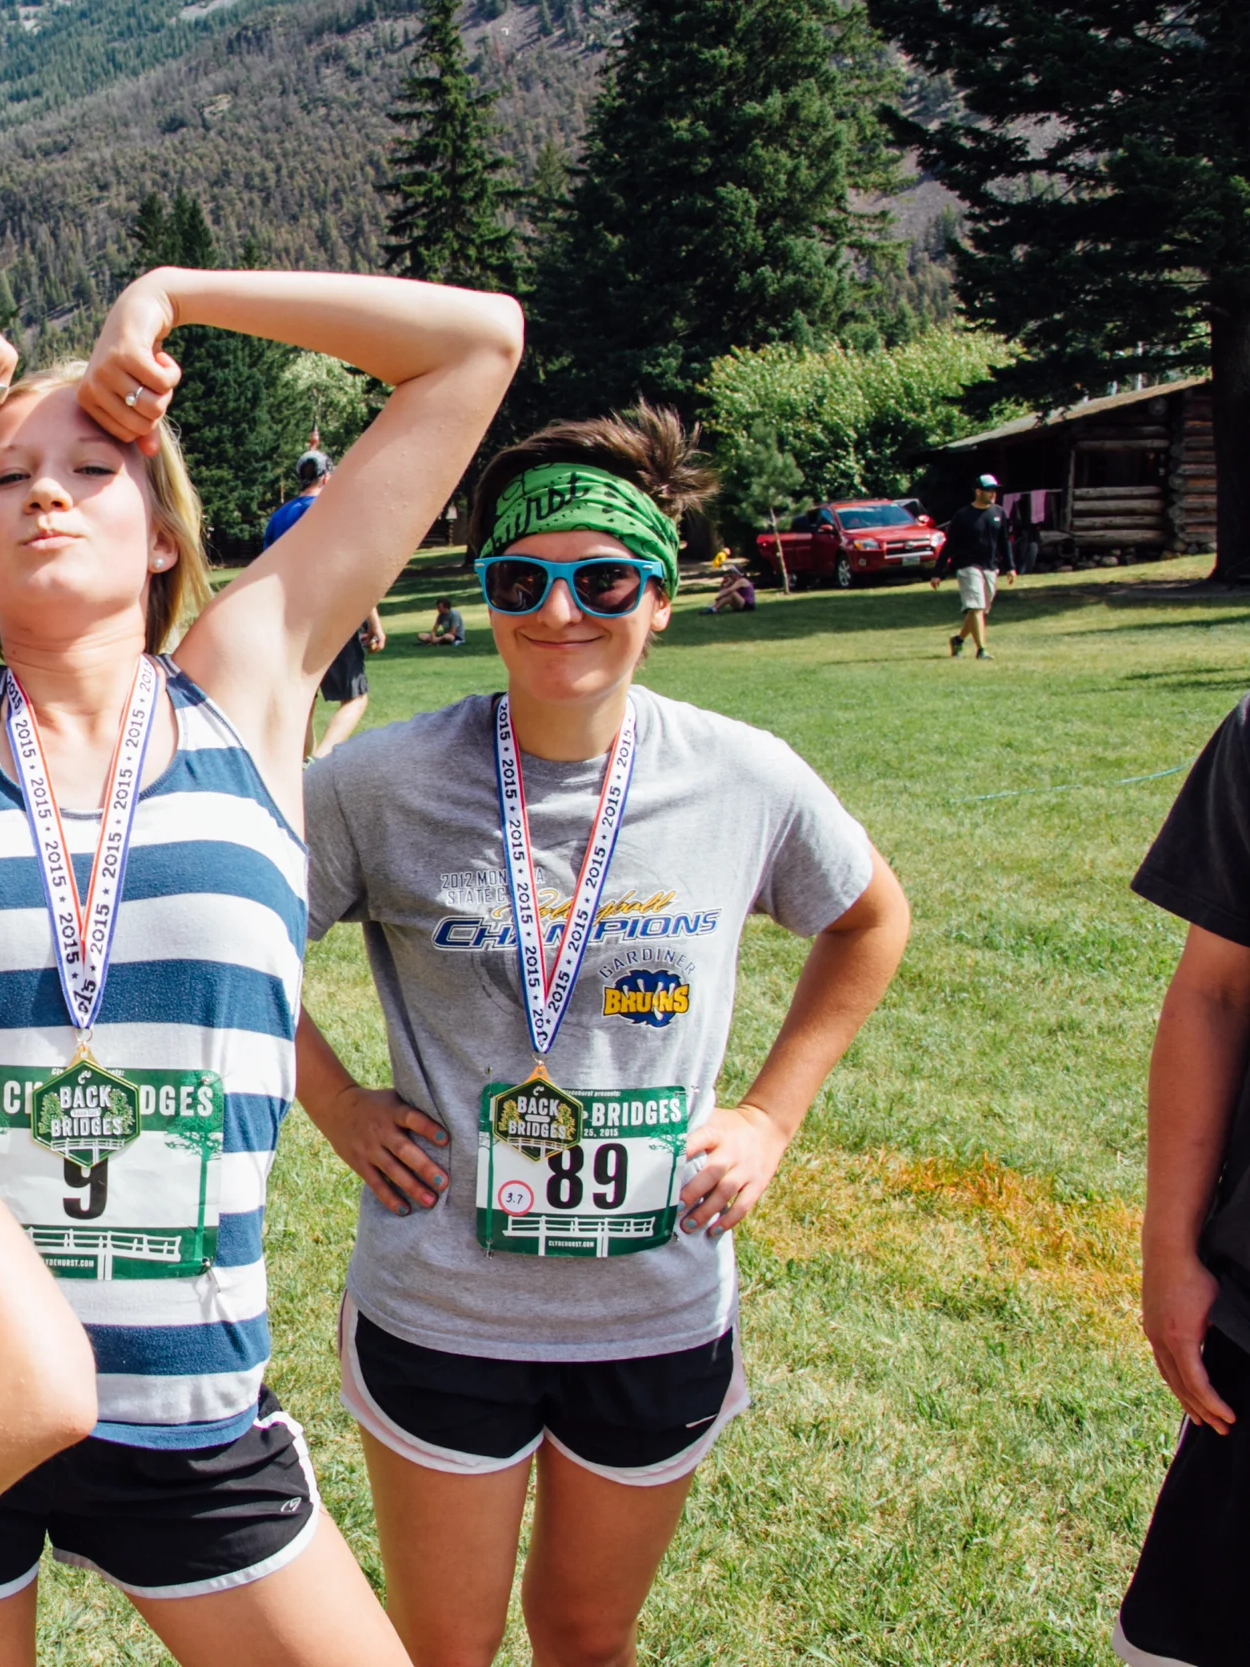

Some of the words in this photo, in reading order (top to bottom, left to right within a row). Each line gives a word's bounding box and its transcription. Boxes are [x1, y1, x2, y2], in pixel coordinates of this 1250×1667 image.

[125, 708, 145, 749] 2015
[499, 702, 511, 742] 2015
[617, 727, 632, 768] 2015
[113, 768, 133, 811] 2015
[502, 759, 517, 799] 2015
[6, 675, 21, 710] 2015
[15, 719, 36, 758] 2015
[30, 777, 51, 819] 2015
[45, 841, 67, 888] 2015
[59, 912, 80, 965] 2015
[602, 784, 621, 828] 2015
[102, 832, 122, 879] 2015
[509, 819, 525, 861] 2015
[441, 872, 472, 889] 2012
[476, 868, 546, 887] MONA
[585, 845, 606, 889] 2015
[448, 888, 491, 905] STATE
[517, 883, 534, 924] 2015
[90, 903, 110, 956] 2015
[433, 908, 722, 950] CHPIONS
[568, 908, 589, 953] 2015
[525, 945, 541, 996] 2015
[599, 947, 696, 980] GARDINER
[548, 970, 571, 1013] 2015
[603, 983, 690, 1016] BRUINS
[60, 1085, 112, 1109] BACK
[140, 1085, 214, 1118] DGES
[517, 1096, 560, 1117] BACK
[591, 1098, 683, 1127] BRIDGES
[51, 1116, 123, 1137] BRIDGES
[508, 1120, 567, 1139] BRIDGES
[600, 1128, 619, 1137] 2015
[62, 1157, 109, 1220] 9
[546, 1142, 629, 1210] 89
[506, 1192, 524, 1205] 3.7
[44, 1258, 95, 1268] YDEHURST.COM
[548, 1240, 595, 1248] CLYDEHURST.COM
